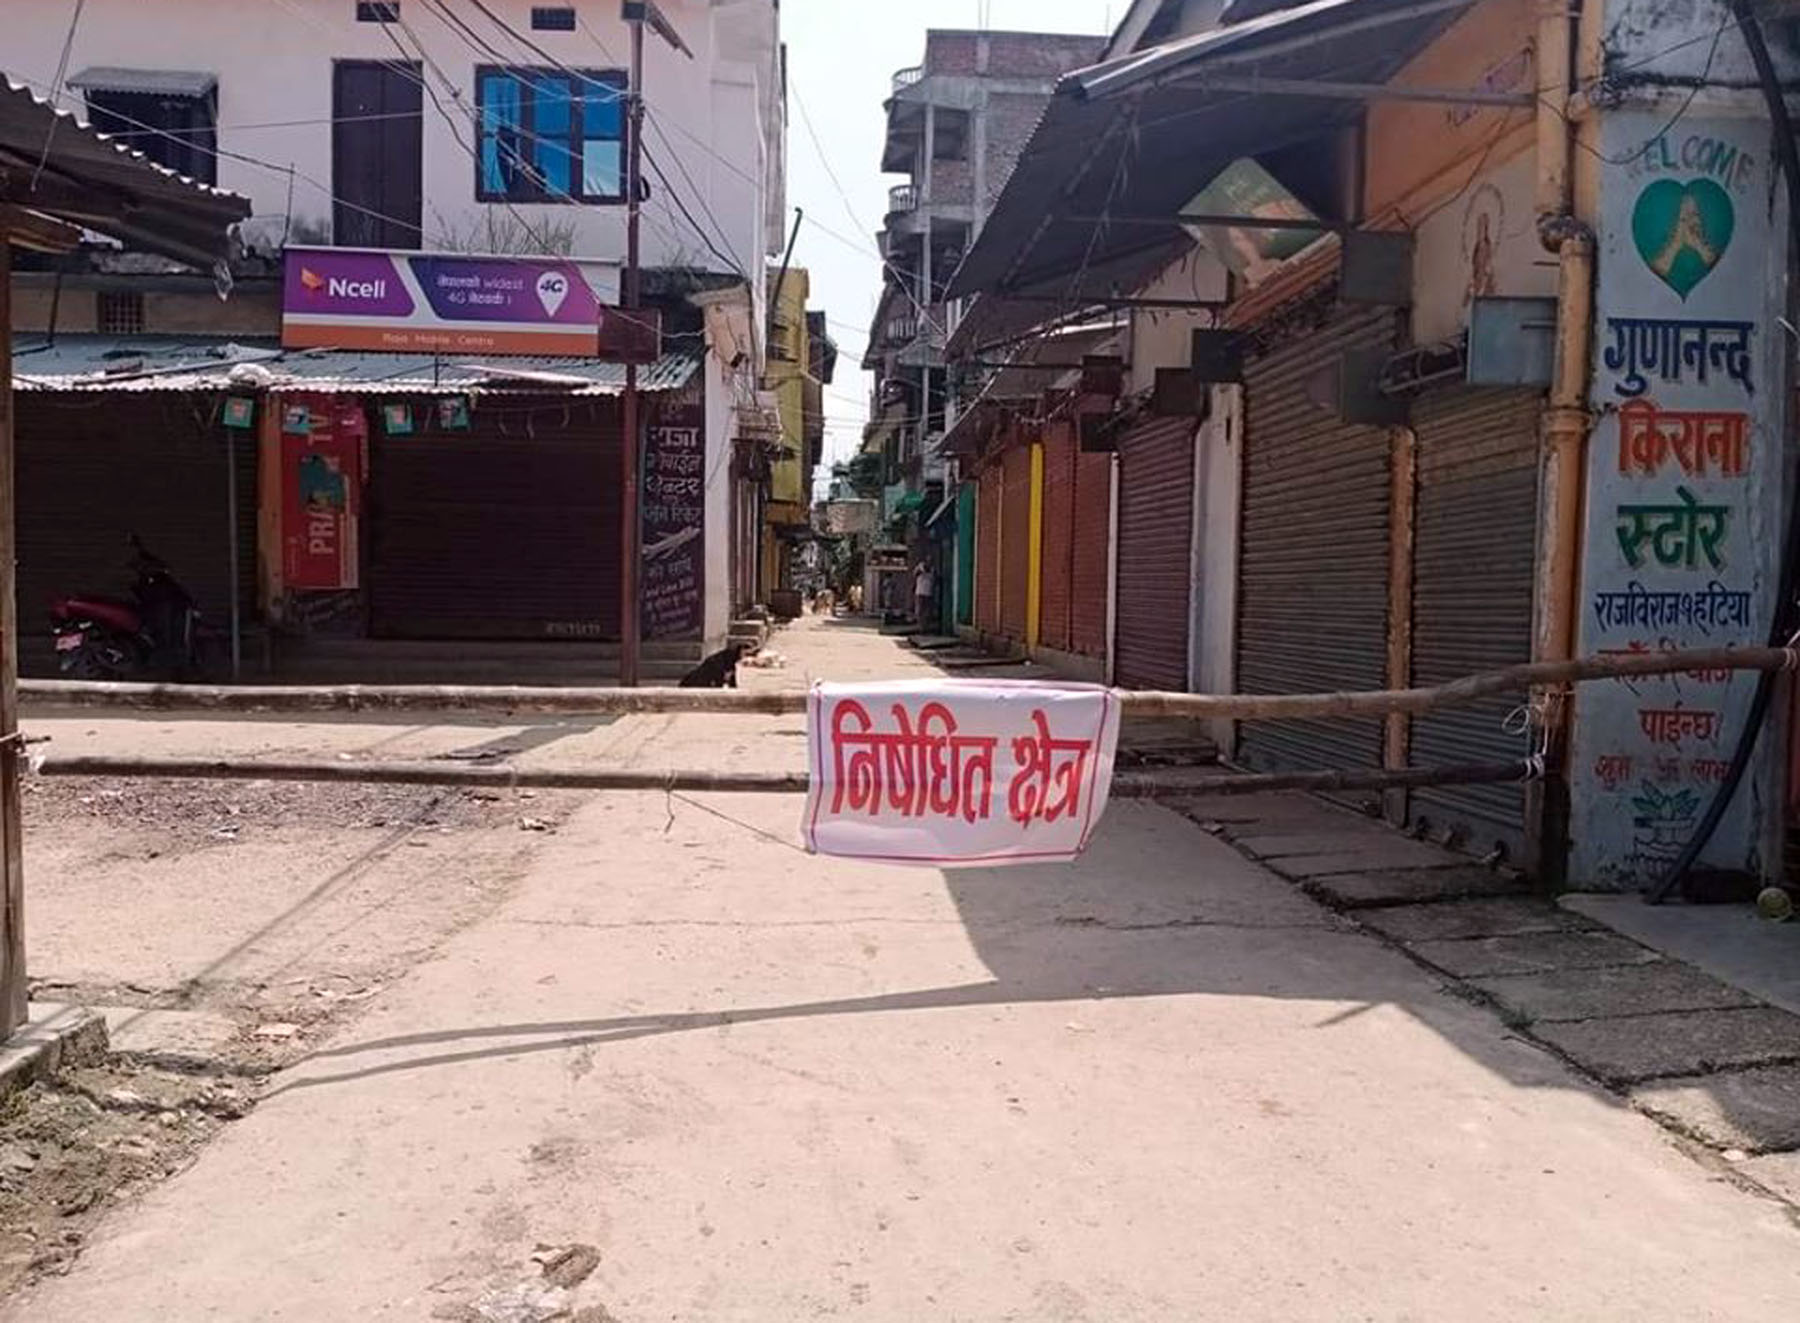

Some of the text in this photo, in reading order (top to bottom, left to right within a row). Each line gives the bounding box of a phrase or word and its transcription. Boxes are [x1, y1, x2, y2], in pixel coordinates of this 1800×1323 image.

[328, 277, 387, 300] Ncell
[540, 278, 564, 293] 4G
[1604, 318, 1755, 396] गुणानन्द
[1617, 399, 1748, 475] किराना
[1615, 485, 1730, 570] स्टोर
[830, 699, 1092, 829] निषेधित क्षेत्र
